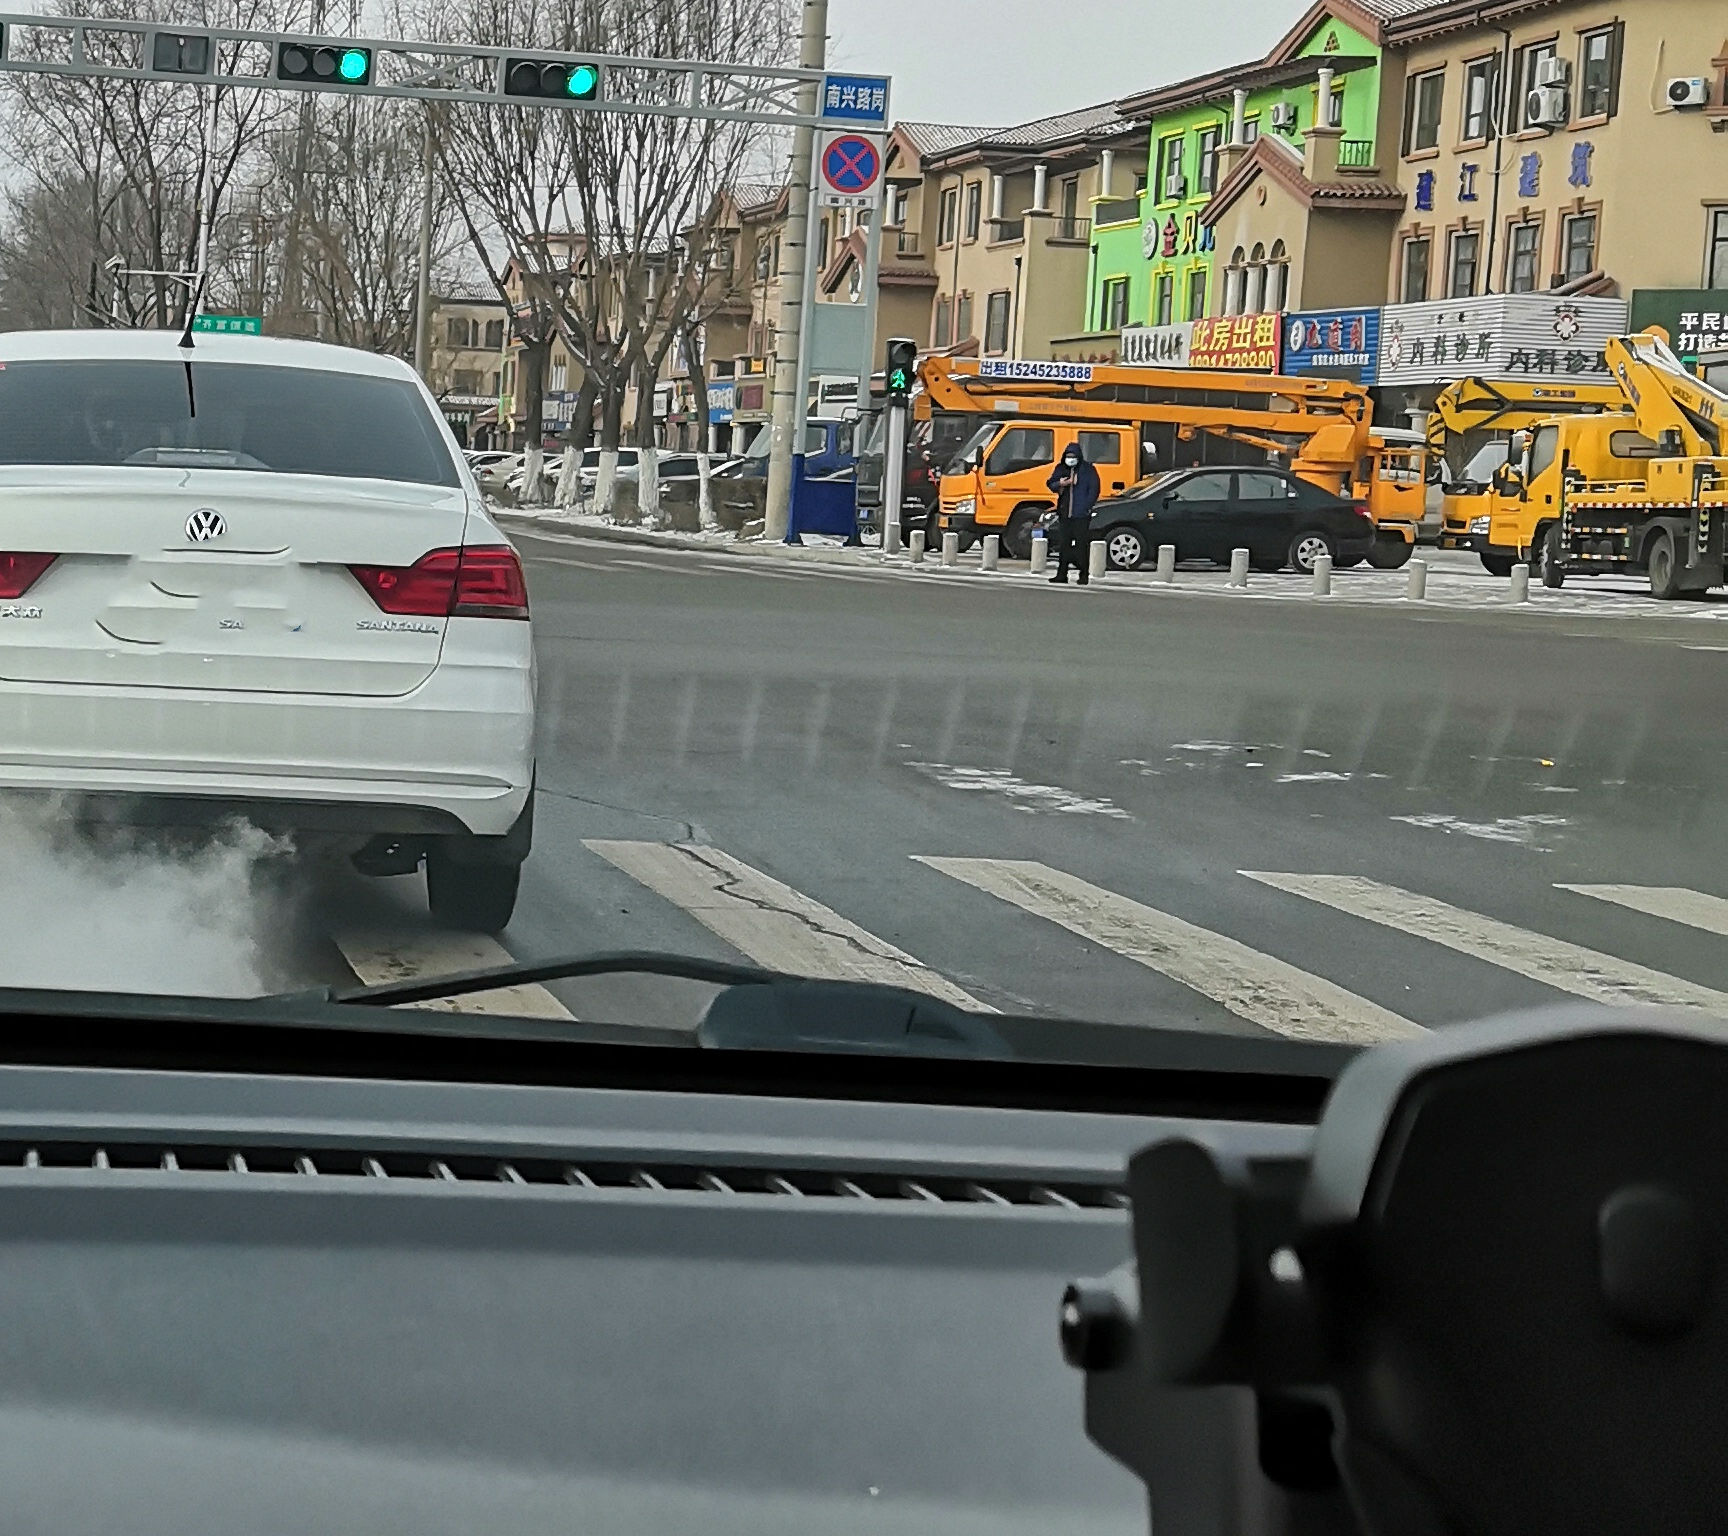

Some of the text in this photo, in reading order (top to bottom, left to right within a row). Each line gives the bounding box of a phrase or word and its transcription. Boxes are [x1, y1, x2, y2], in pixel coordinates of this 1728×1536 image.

[826, 84, 884, 112] 南兴路岗
[1190, 314, 1277, 352] 此房出租
[1679, 312, 1728, 331] 平民
[355, 619, 440, 635] SANTANA
